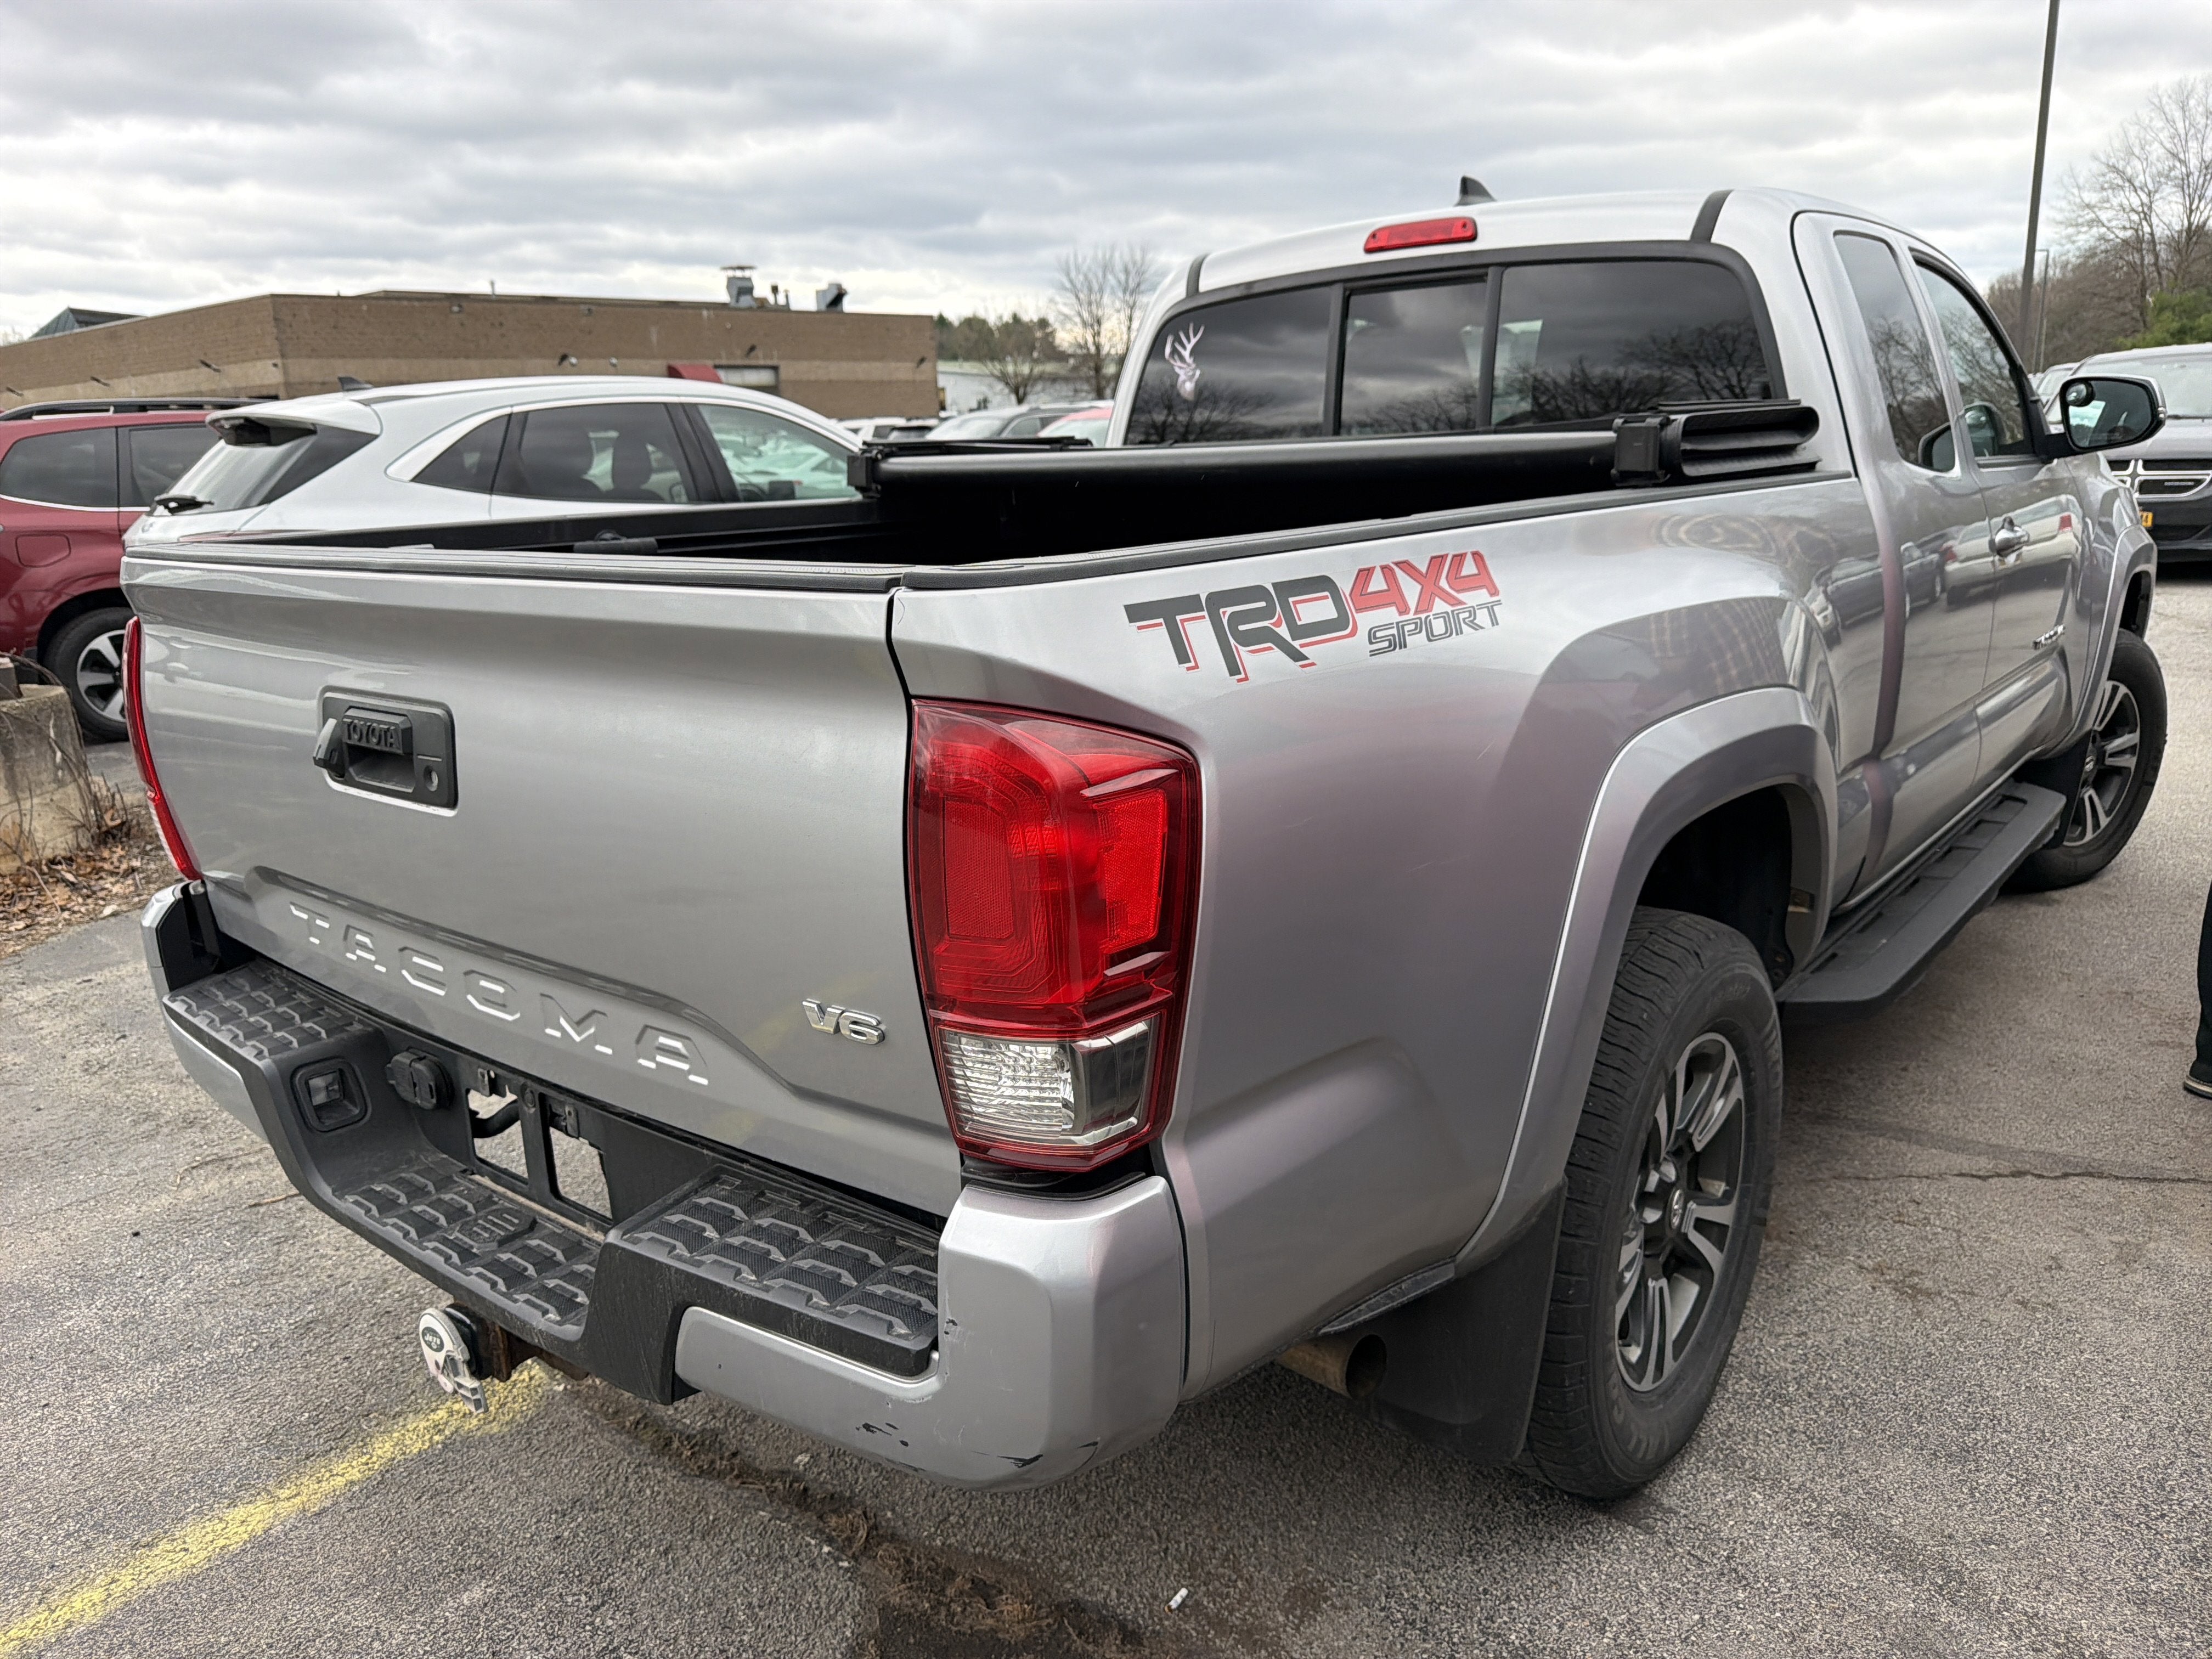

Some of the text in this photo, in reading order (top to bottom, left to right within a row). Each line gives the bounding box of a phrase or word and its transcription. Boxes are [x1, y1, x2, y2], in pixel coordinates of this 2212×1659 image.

[1124, 574, 1358, 684] TRD
[1368, 599, 1503, 657] SPORT
[342, 718, 400, 748] TOYOTA
[289, 901, 709, 1086] TACOMA
[802, 998, 887, 1045] V6
